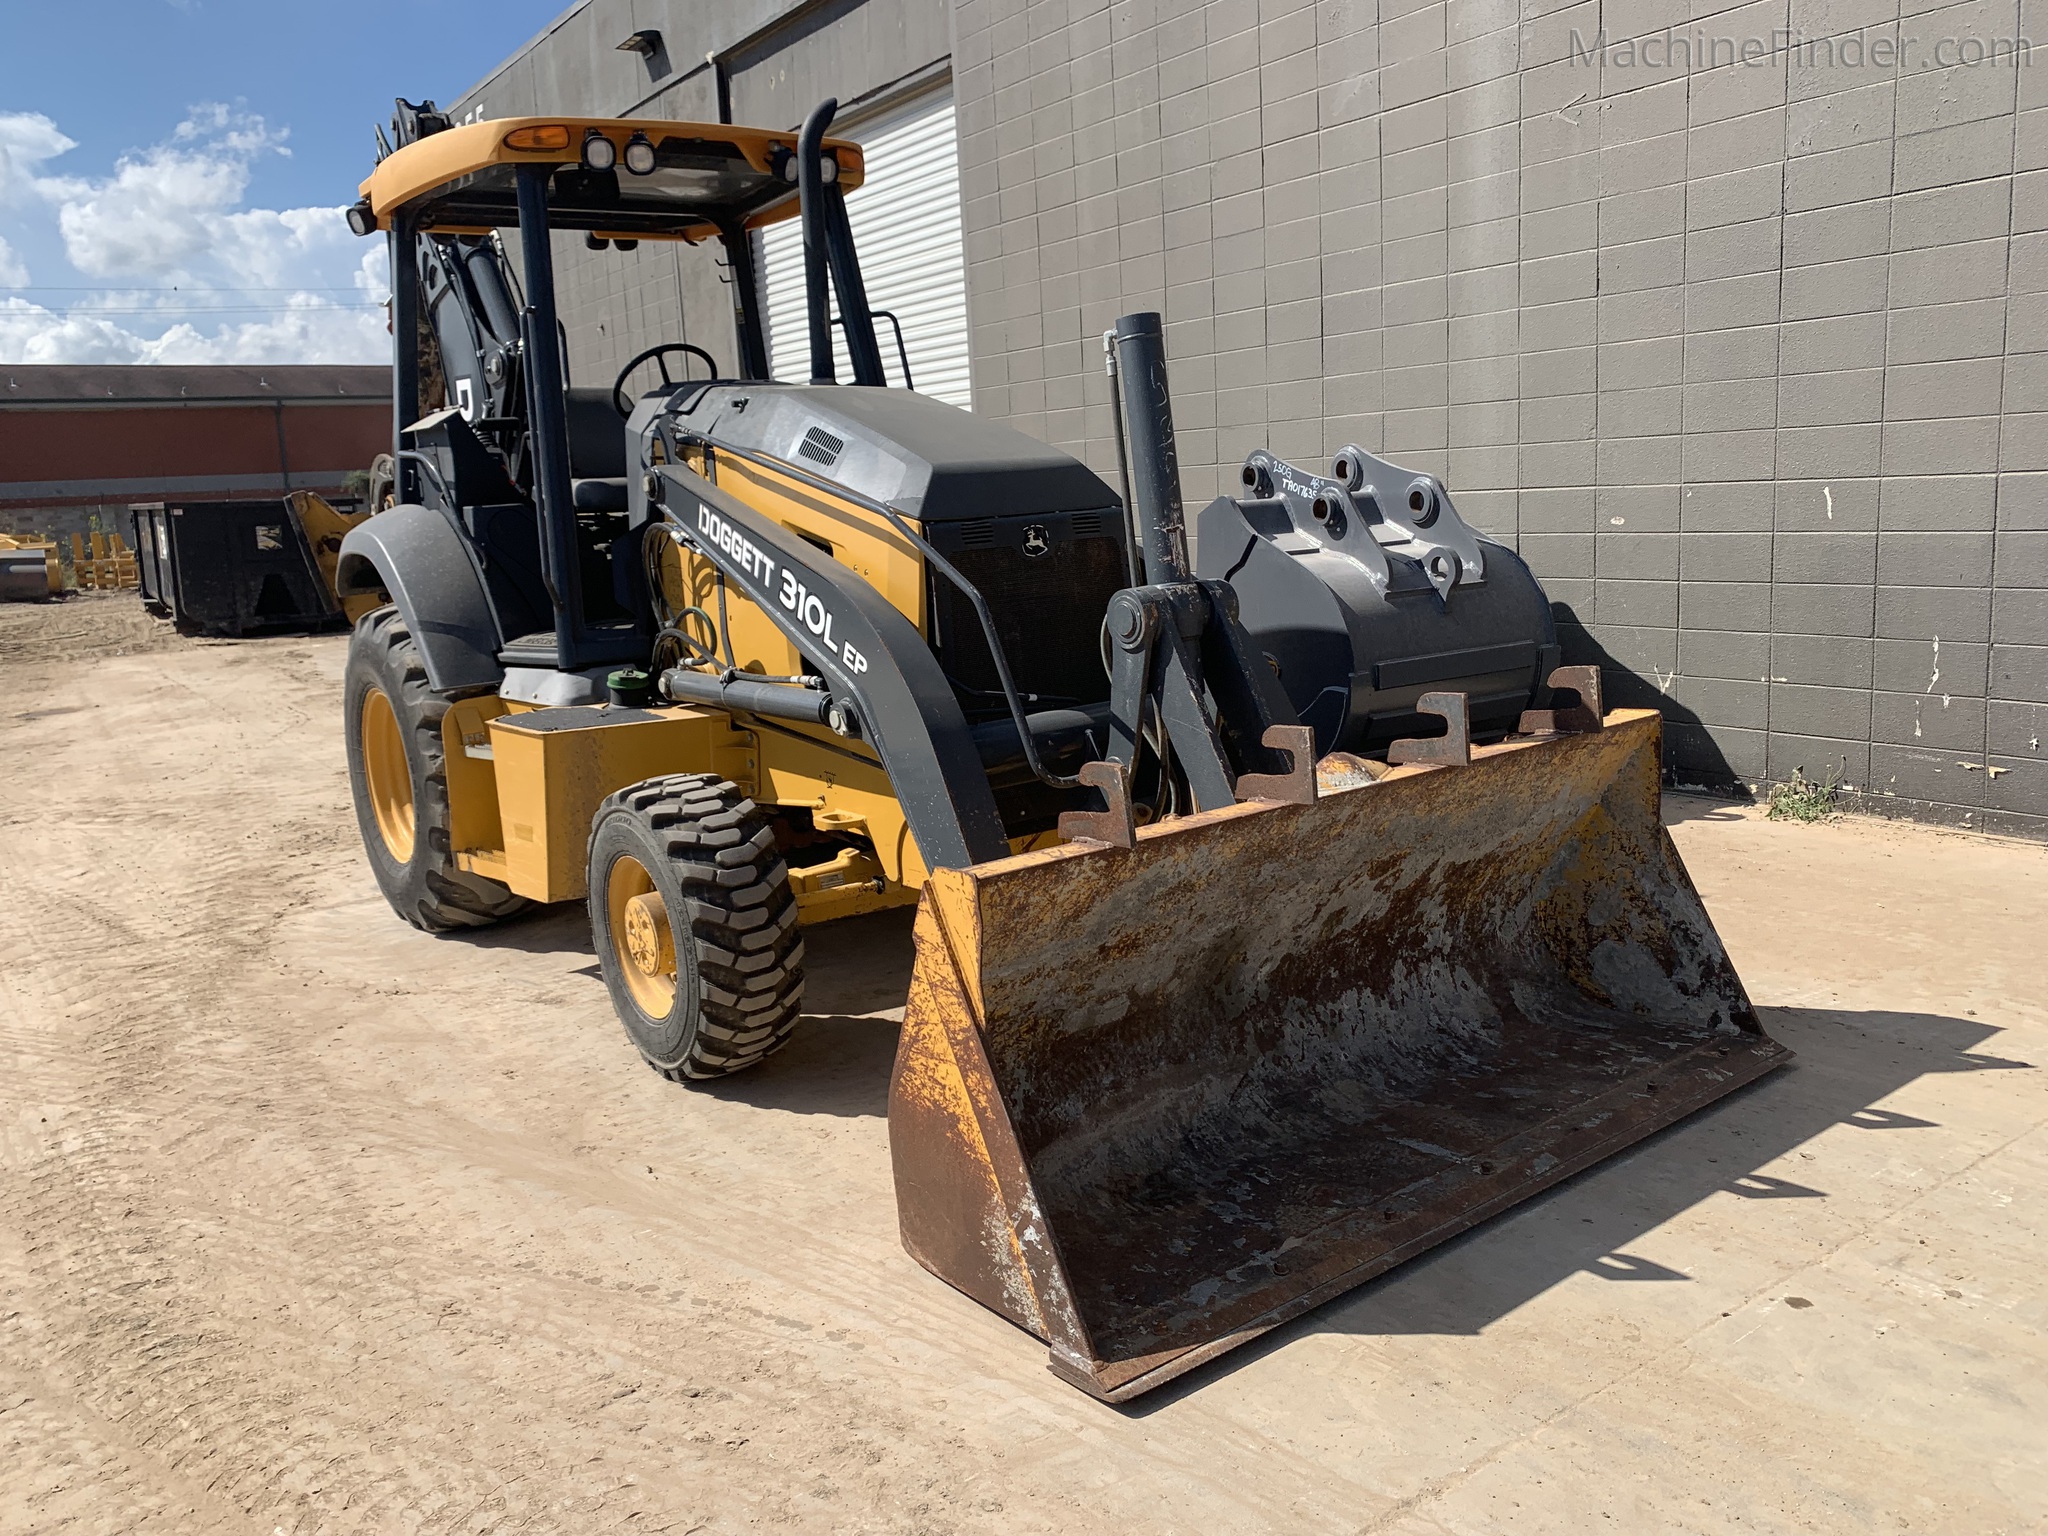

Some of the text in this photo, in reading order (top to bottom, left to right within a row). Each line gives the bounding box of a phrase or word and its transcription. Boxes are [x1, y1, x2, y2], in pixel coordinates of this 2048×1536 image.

[698, 502, 868, 675] DOGGETT 310L EP
